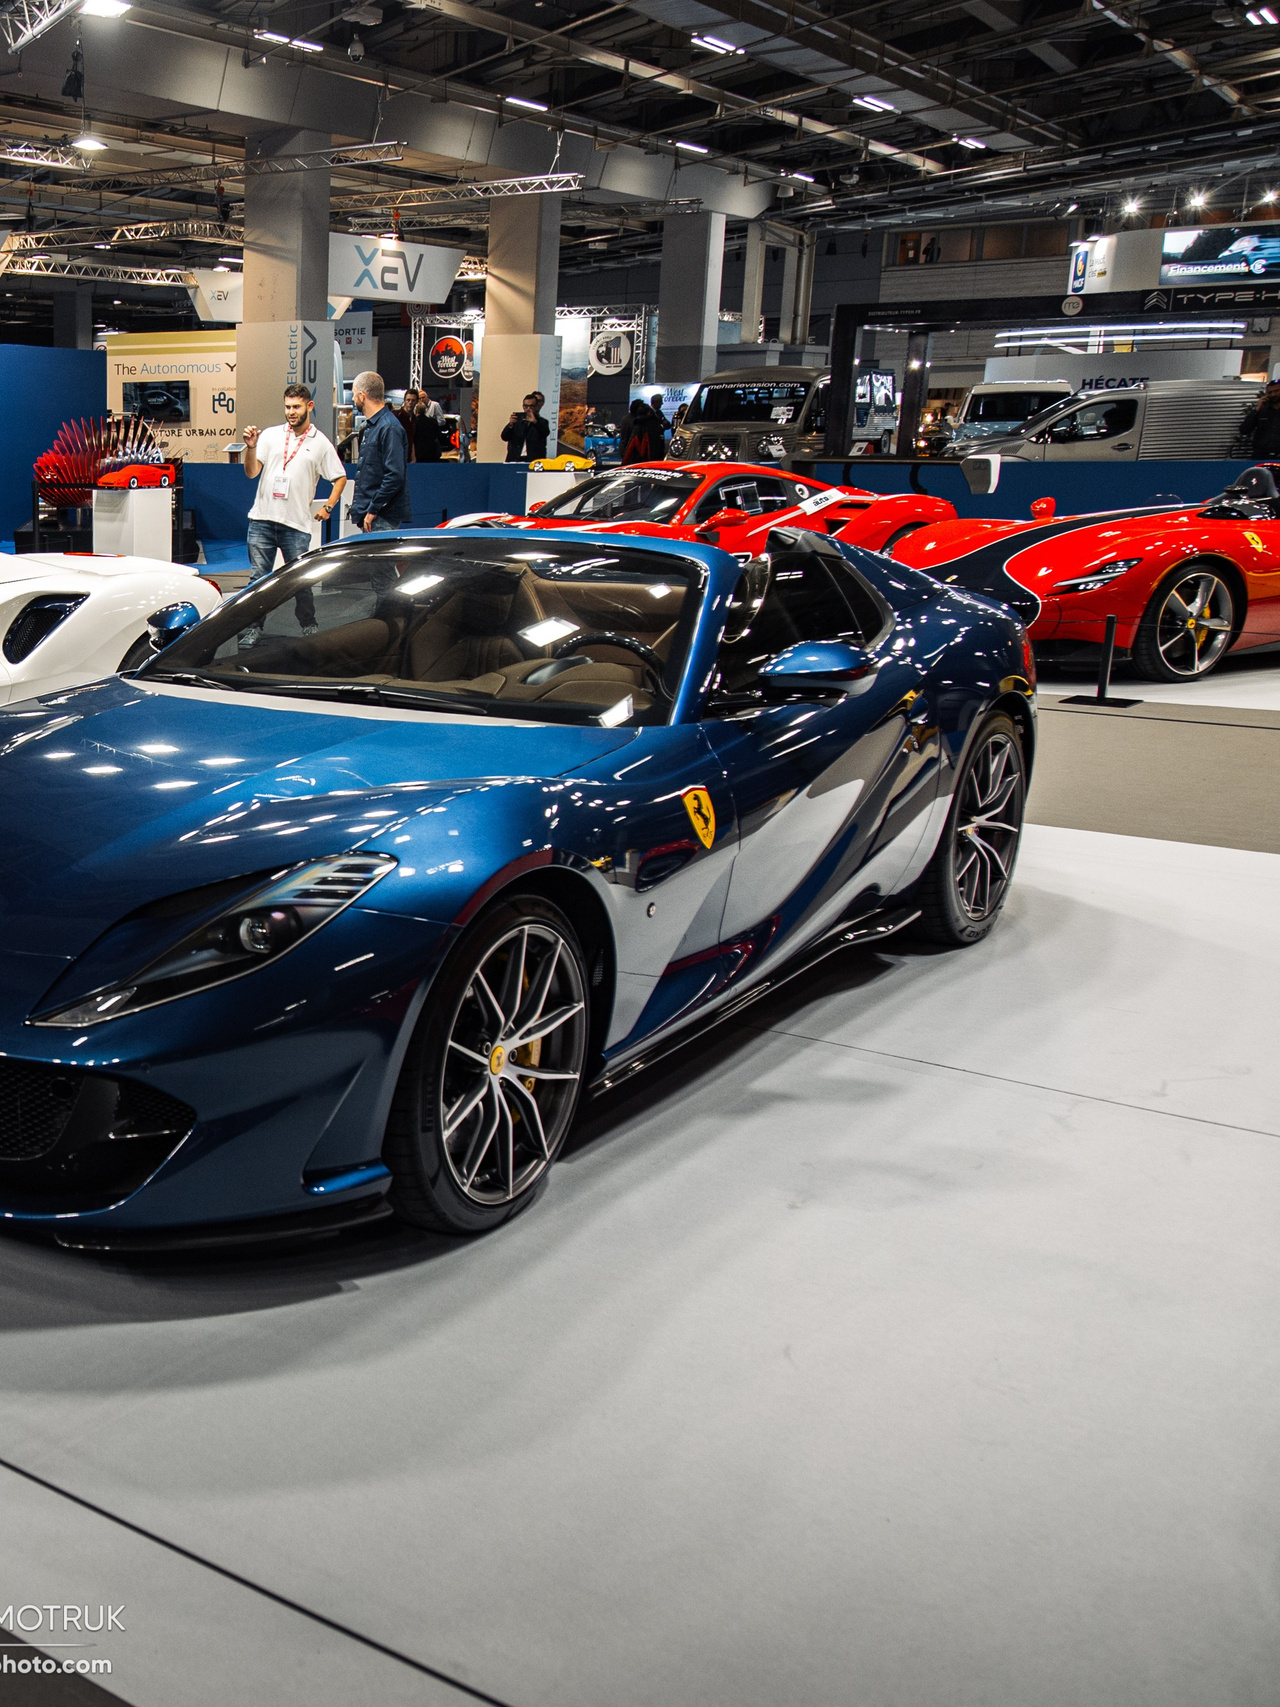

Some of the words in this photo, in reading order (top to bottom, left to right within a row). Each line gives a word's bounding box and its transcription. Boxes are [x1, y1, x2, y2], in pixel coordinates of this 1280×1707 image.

[353, 244, 424, 292] XEV
[210, 290, 229, 301] XEV
[334, 328, 366, 336] SORTIE
[287, 325, 298, 384] Electric
[114, 363, 137, 375] The
[140, 363, 222, 375] Autonomous
[225, 362, 236, 372] Y
[708, 382, 801, 390] meharievasion.com
[212, 392, 236, 413] teo
[152, 429, 182, 438] UTURE
[186, 428, 217, 438] URBAN
